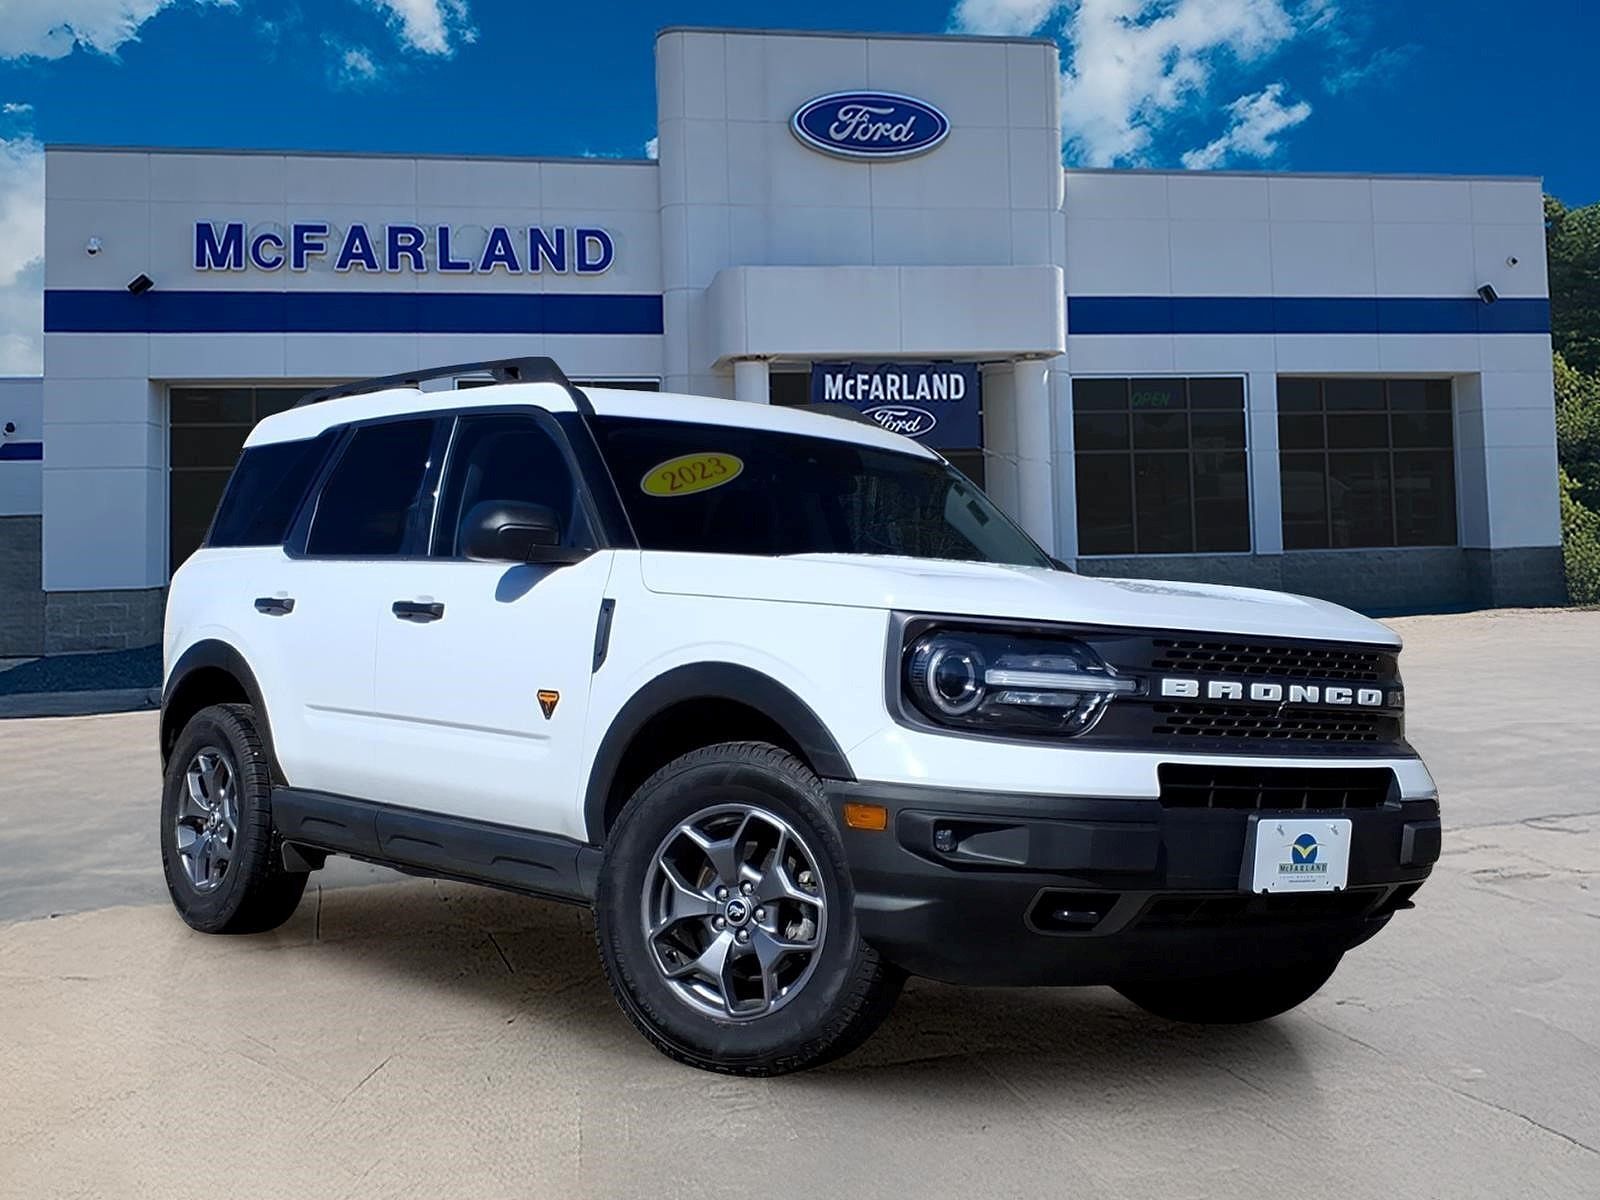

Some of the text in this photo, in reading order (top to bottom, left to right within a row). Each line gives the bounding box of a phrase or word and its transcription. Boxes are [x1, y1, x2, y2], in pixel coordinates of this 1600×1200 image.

[829, 104, 916, 142] Ford
[193, 222, 616, 274] McFARLAND
[824, 373, 966, 401] McFARLAND
[1132, 391, 1170, 407] OPEN
[874, 409, 921, 433] Ford
[662, 457, 727, 491] 2023
[1161, 678, 1383, 706] BRONCO
